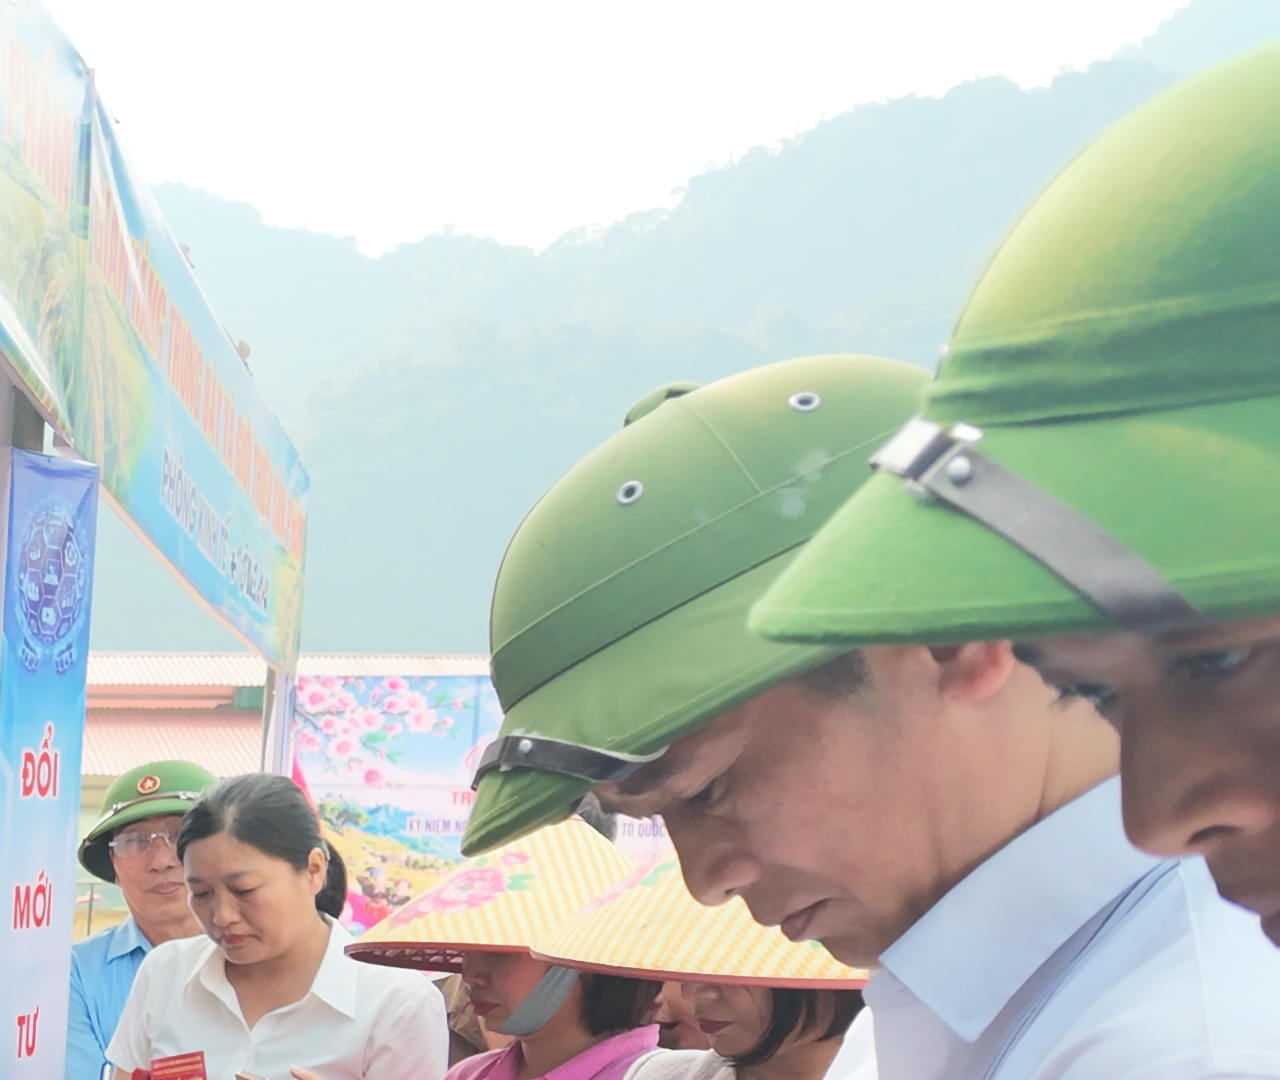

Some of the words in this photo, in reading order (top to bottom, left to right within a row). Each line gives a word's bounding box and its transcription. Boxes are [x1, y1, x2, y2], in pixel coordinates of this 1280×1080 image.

[22, 726, 58, 797] ĐỔI
[13, 870, 52, 929] MỚI
[17, 1006, 39, 1058] TƯ
